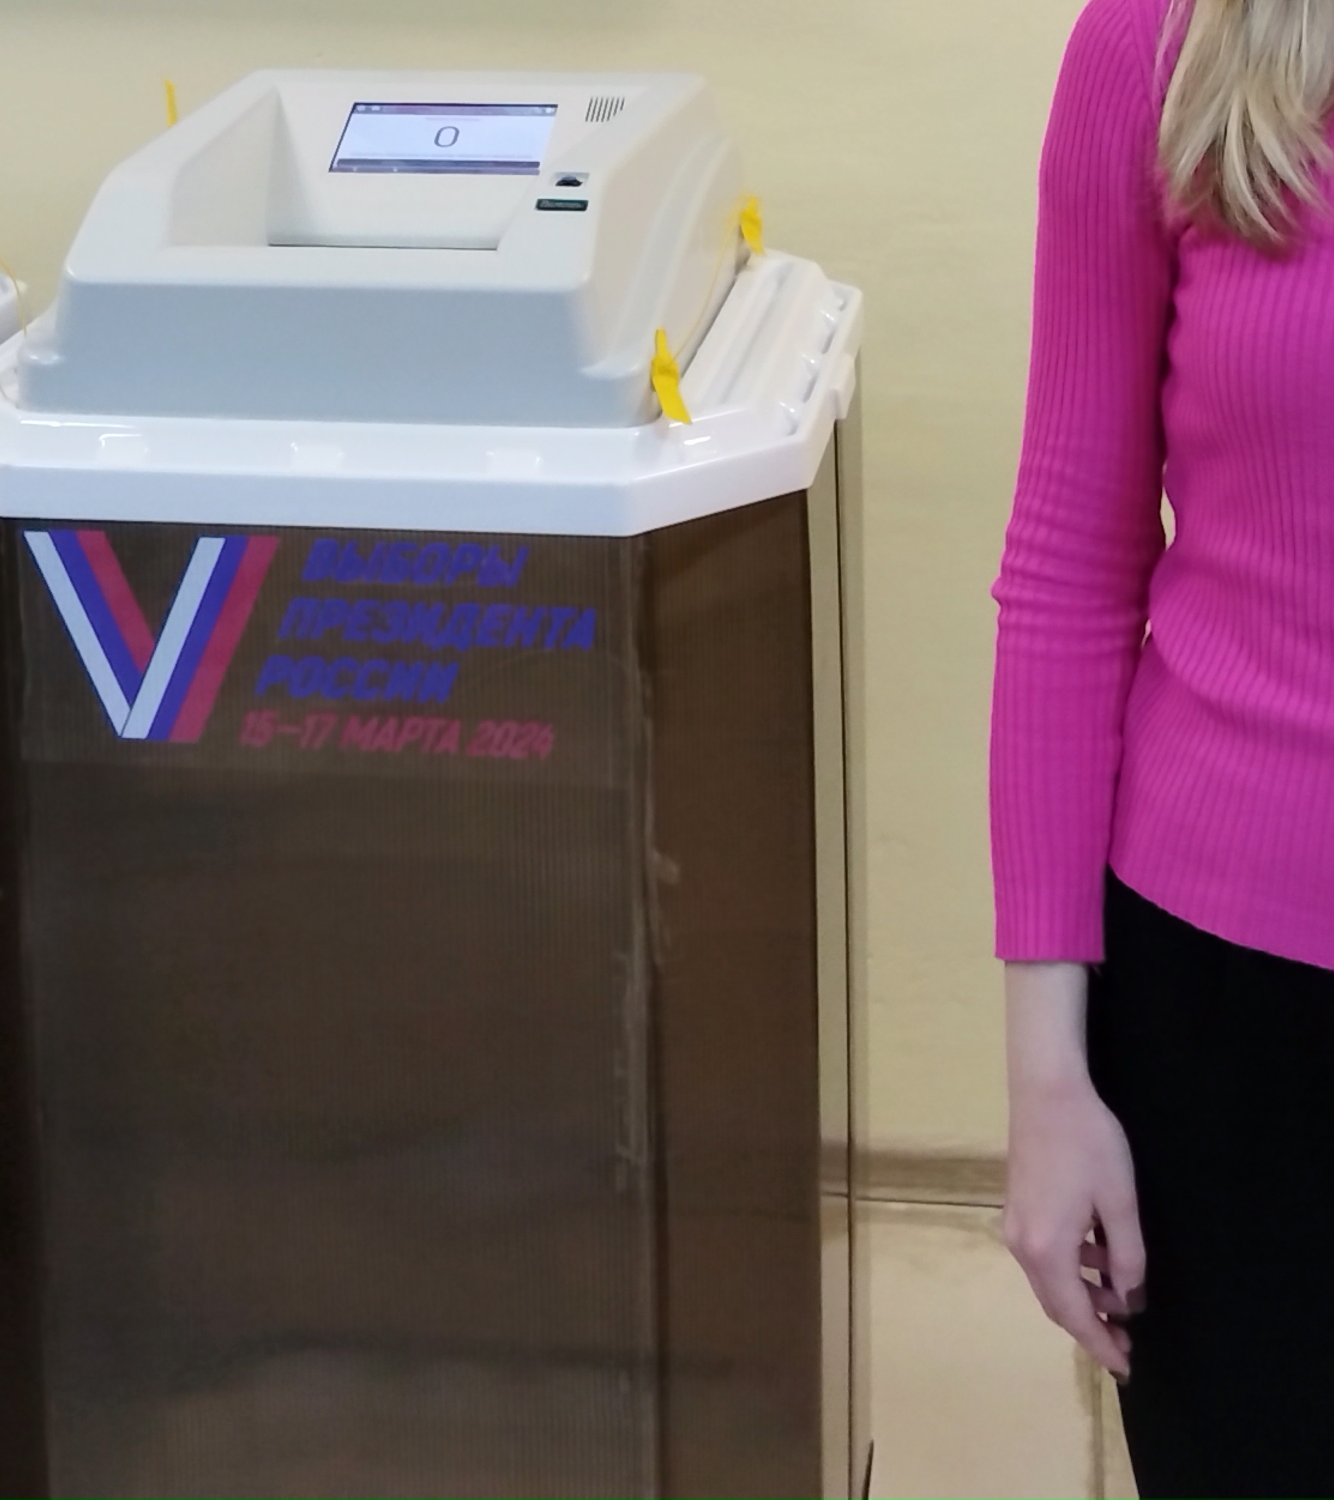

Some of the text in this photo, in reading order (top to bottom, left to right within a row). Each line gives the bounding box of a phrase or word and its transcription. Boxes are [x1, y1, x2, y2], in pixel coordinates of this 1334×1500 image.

[433, 126, 460, 148] 0
[301, 537, 530, 588] ВЫБОРЫ
[277, 597, 596, 652] ПРЕЗИДЕНТА
[254, 655, 460, 703] РОССИИ
[339, 713, 462, 756] МАРТА
[466, 720, 555, 760] 2024
